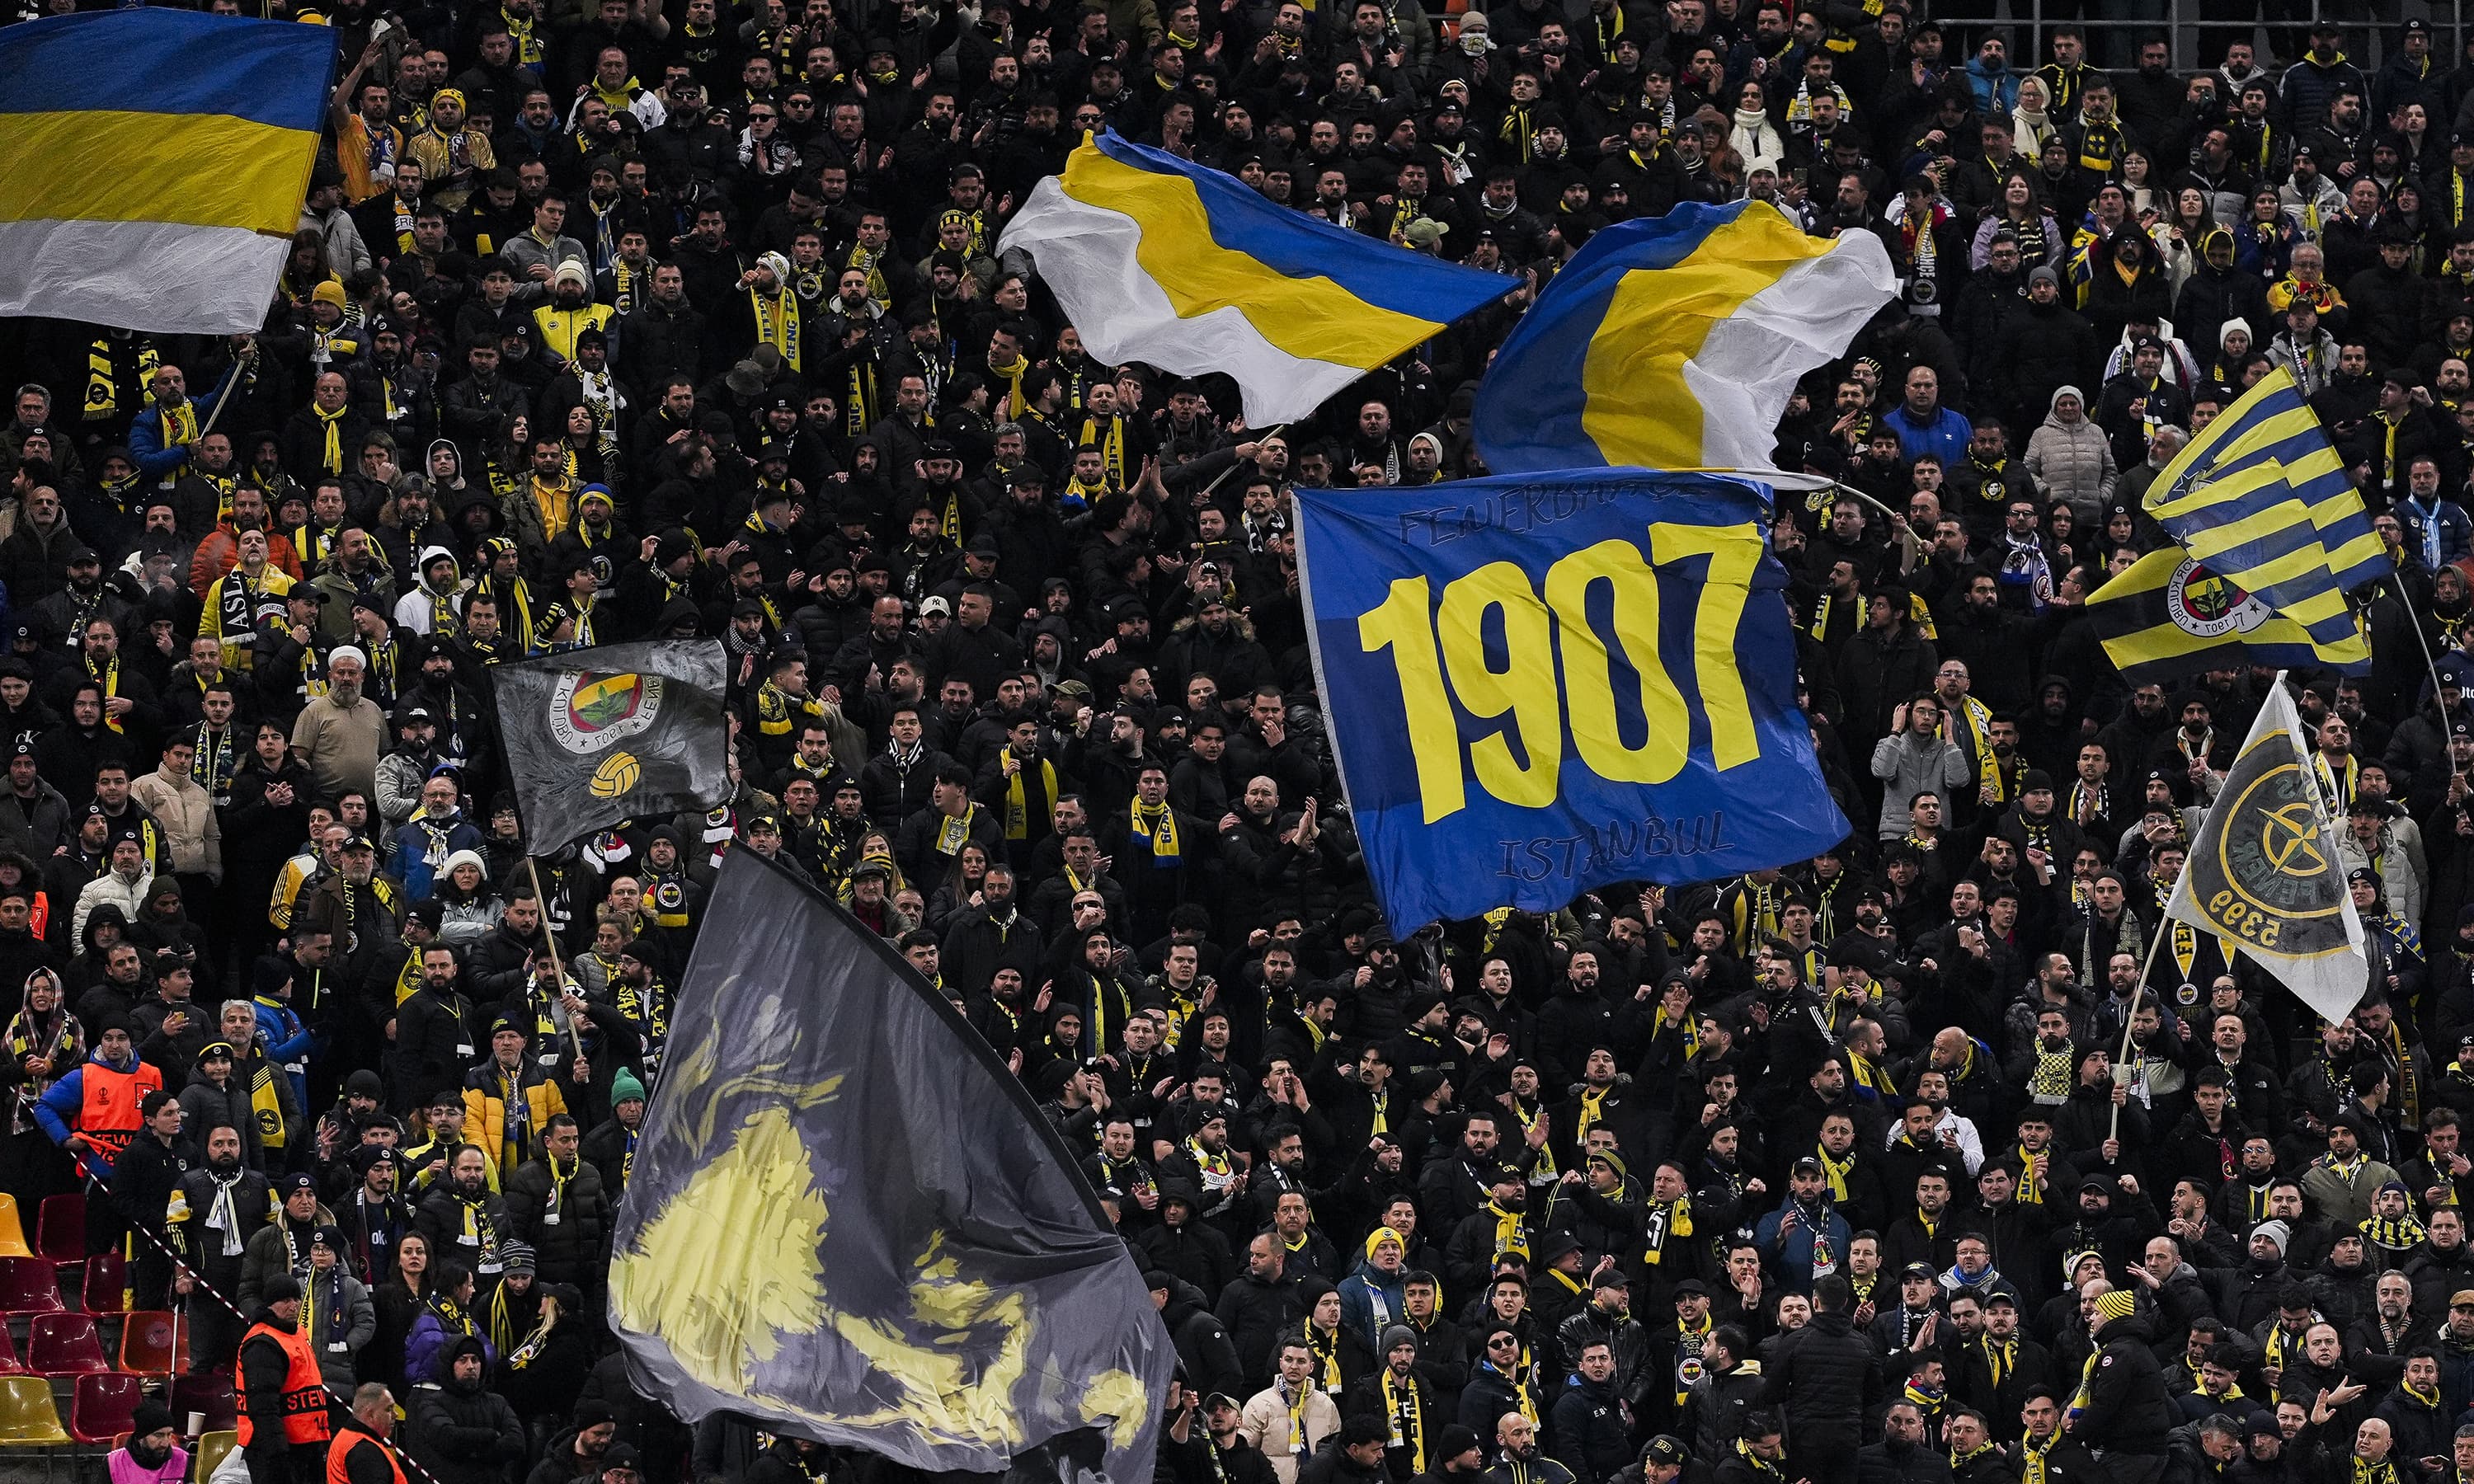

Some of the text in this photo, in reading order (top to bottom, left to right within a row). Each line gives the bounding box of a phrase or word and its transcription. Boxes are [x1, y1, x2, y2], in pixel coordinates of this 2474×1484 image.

[1357, 521, 1763, 825] 1907
[1496, 810, 1735, 882] ISTANBUL
[286, 1389, 327, 1411] STEW
